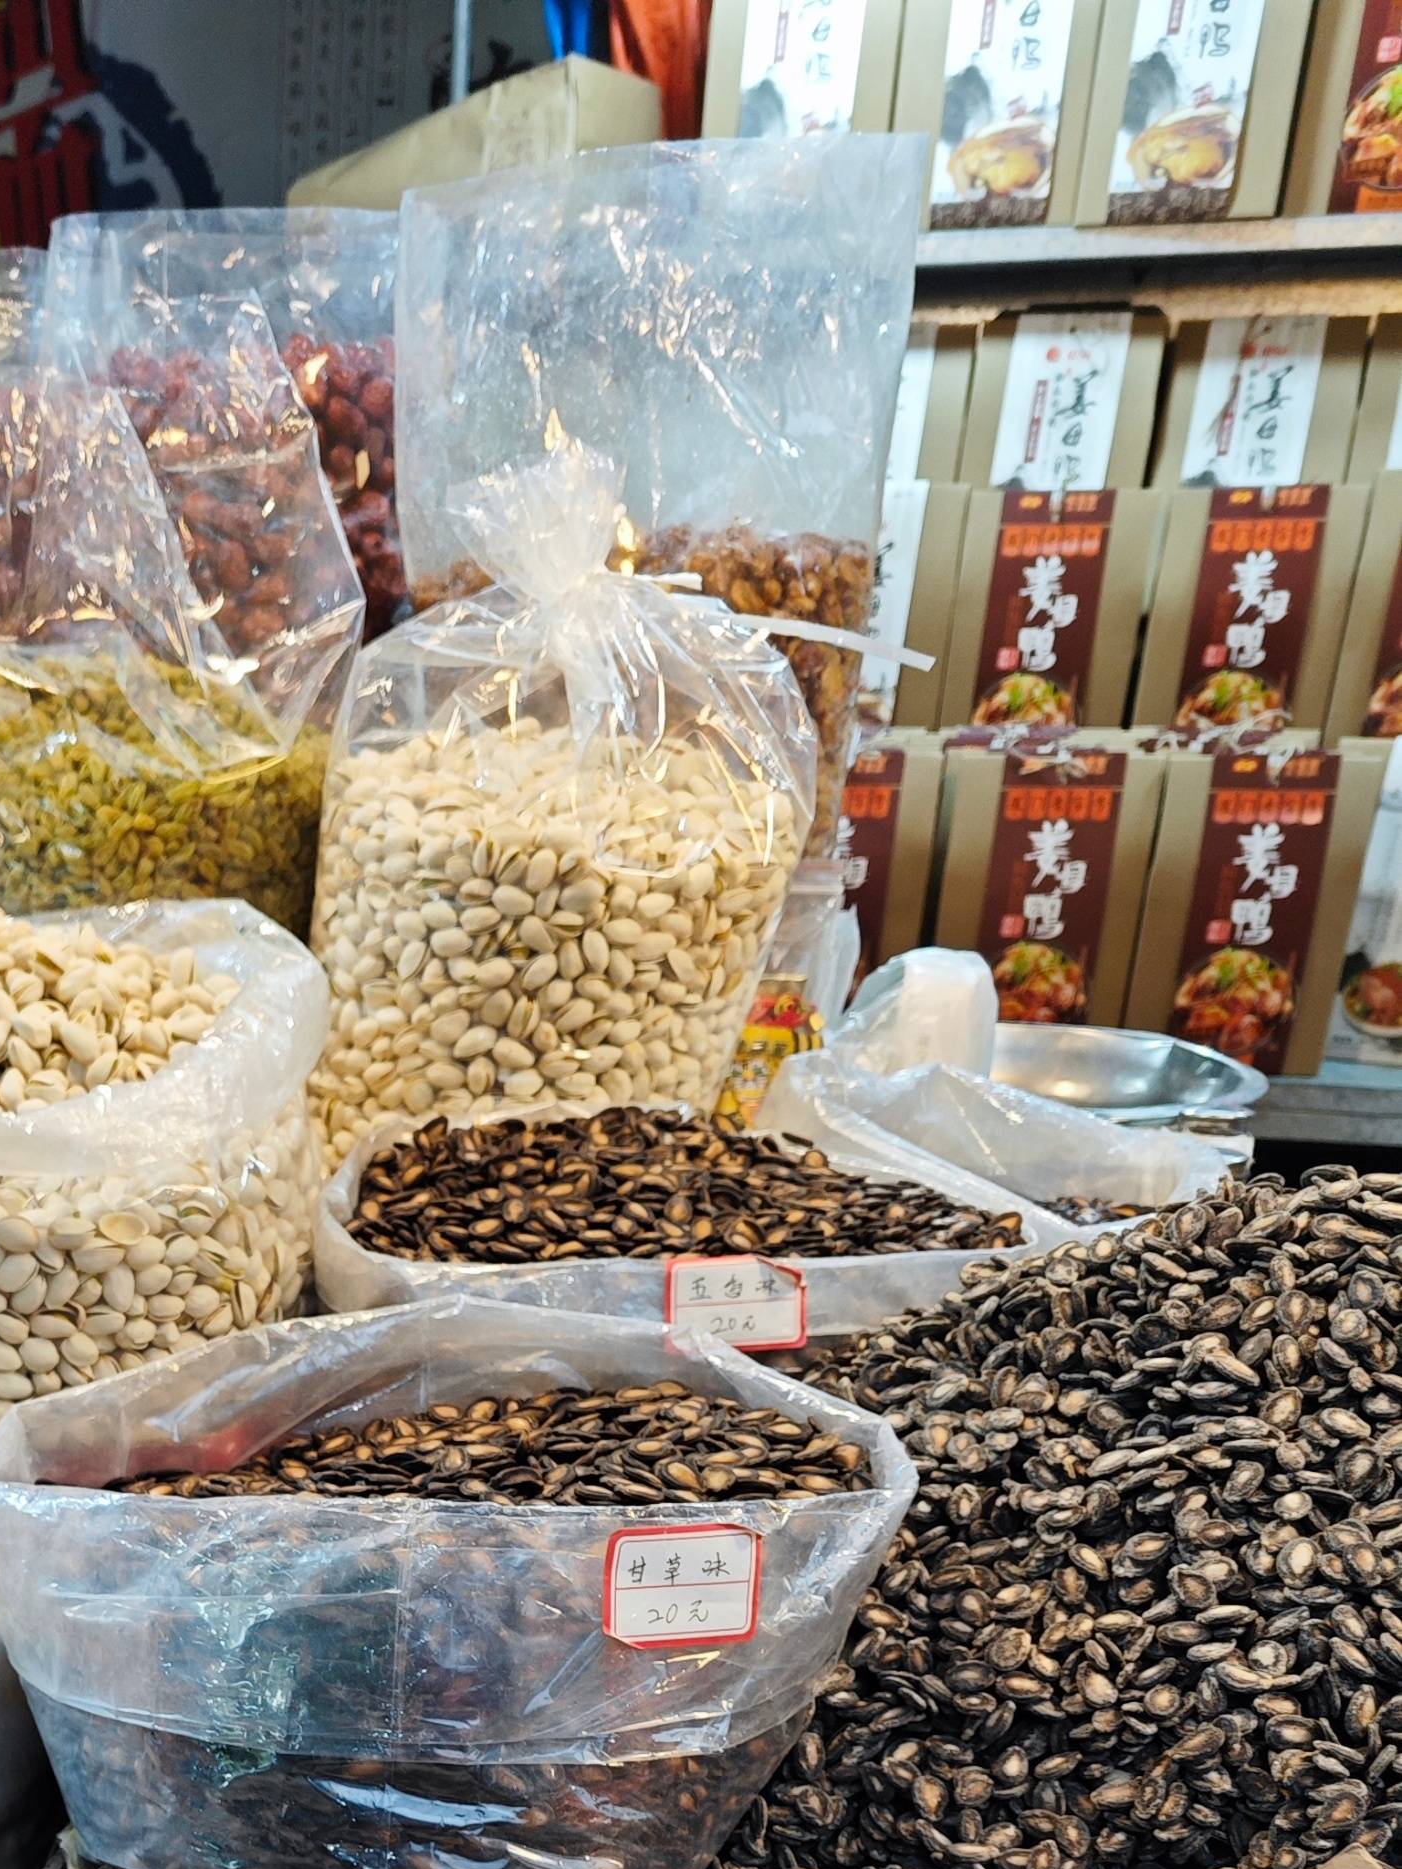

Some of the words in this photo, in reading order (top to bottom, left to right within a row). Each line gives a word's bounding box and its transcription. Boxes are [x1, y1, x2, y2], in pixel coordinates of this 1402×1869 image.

[1022, 817, 1089, 941] 姜母鸭
[1229, 821, 1300, 946] 姜母鸭
[688, 1274, 781, 1302] 五香味
[710, 1315, 757, 1335] 20元
[627, 1551, 731, 1586] 甘草味
[647, 1599, 710, 1625] 20元
